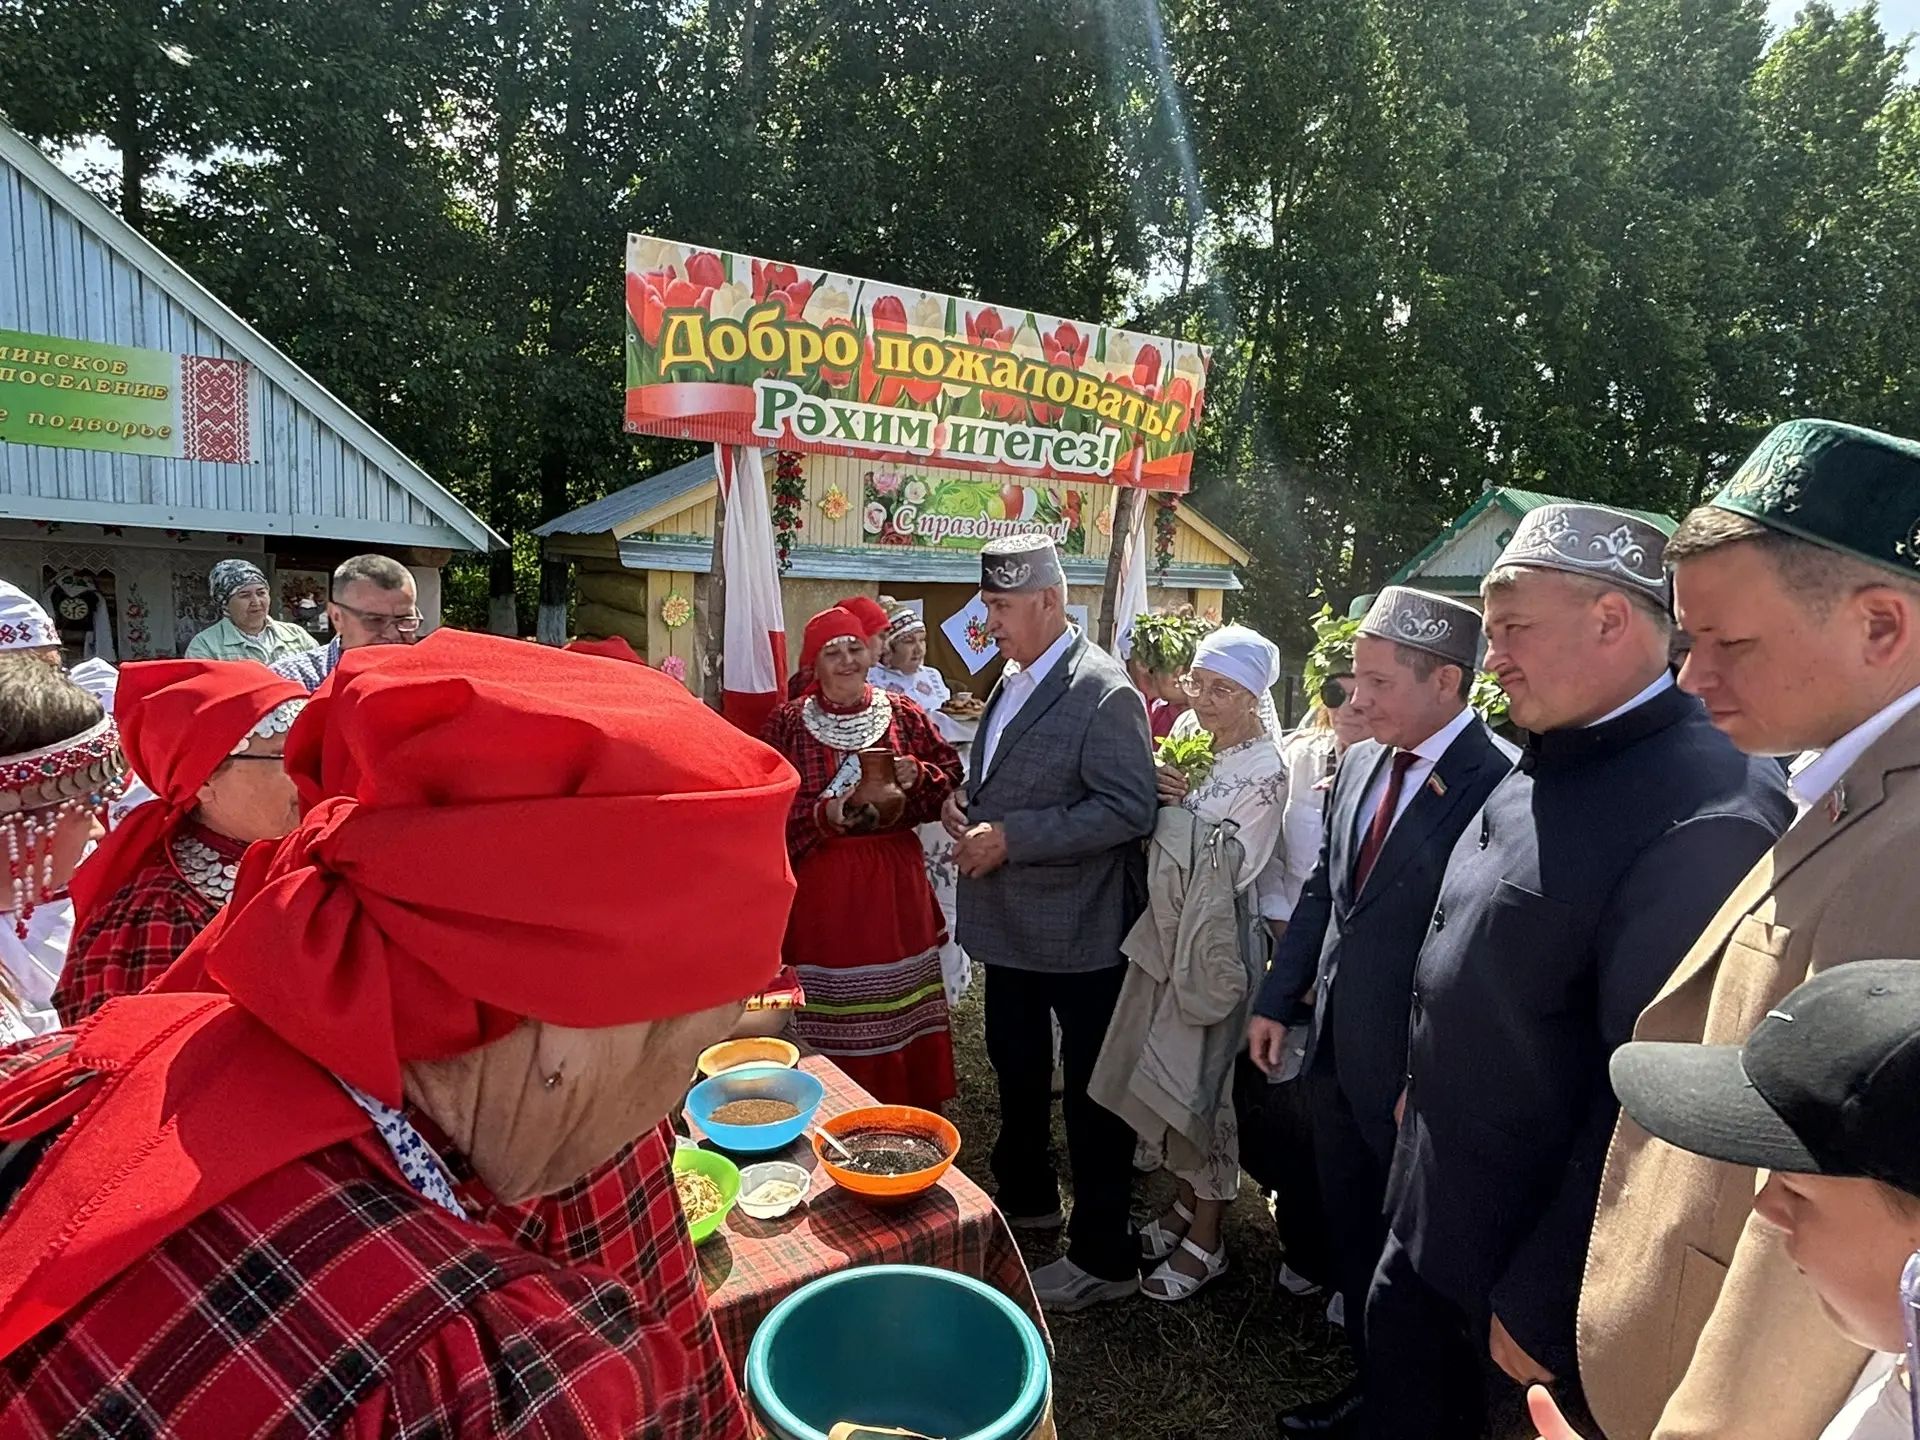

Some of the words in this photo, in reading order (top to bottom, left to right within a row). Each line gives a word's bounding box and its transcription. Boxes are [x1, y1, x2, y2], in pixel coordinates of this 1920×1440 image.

[0, 367, 168, 399] ПОСЕЛЕНИЕ
[660, 303, 859, 376] Добро
[879, 335, 1183, 442] пожаловать!
[28, 412, 171, 438] подворье
[758, 386, 932, 449] Рәхим
[951, 422, 1117, 470] итегез!
[896, 509, 914, 532] С
[920, 511, 1069, 541] праздником!
